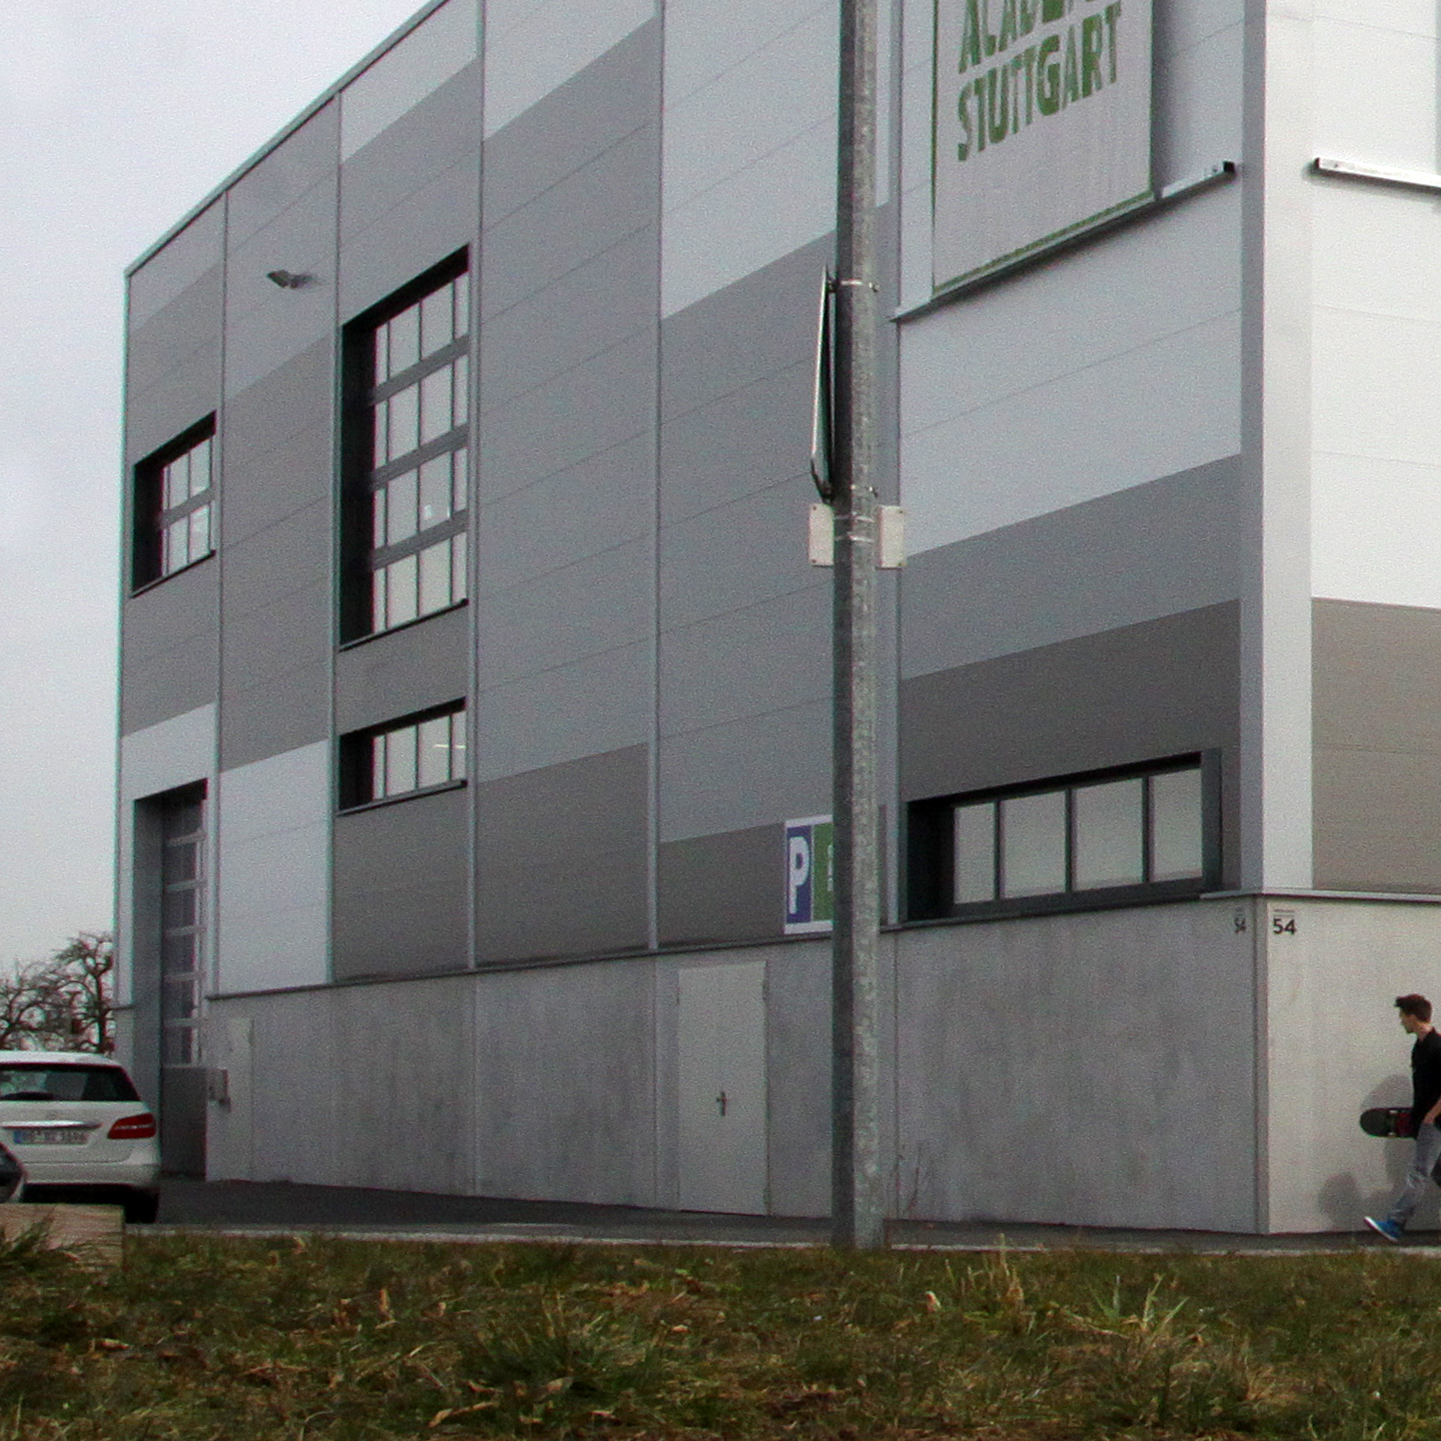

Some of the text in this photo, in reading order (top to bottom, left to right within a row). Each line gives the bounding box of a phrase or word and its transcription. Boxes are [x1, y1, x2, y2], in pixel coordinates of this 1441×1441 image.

[957, 0, 1121, 161] STUTTGART
[788, 836, 810, 914] P
[1273, 917, 1297, 935] 54
